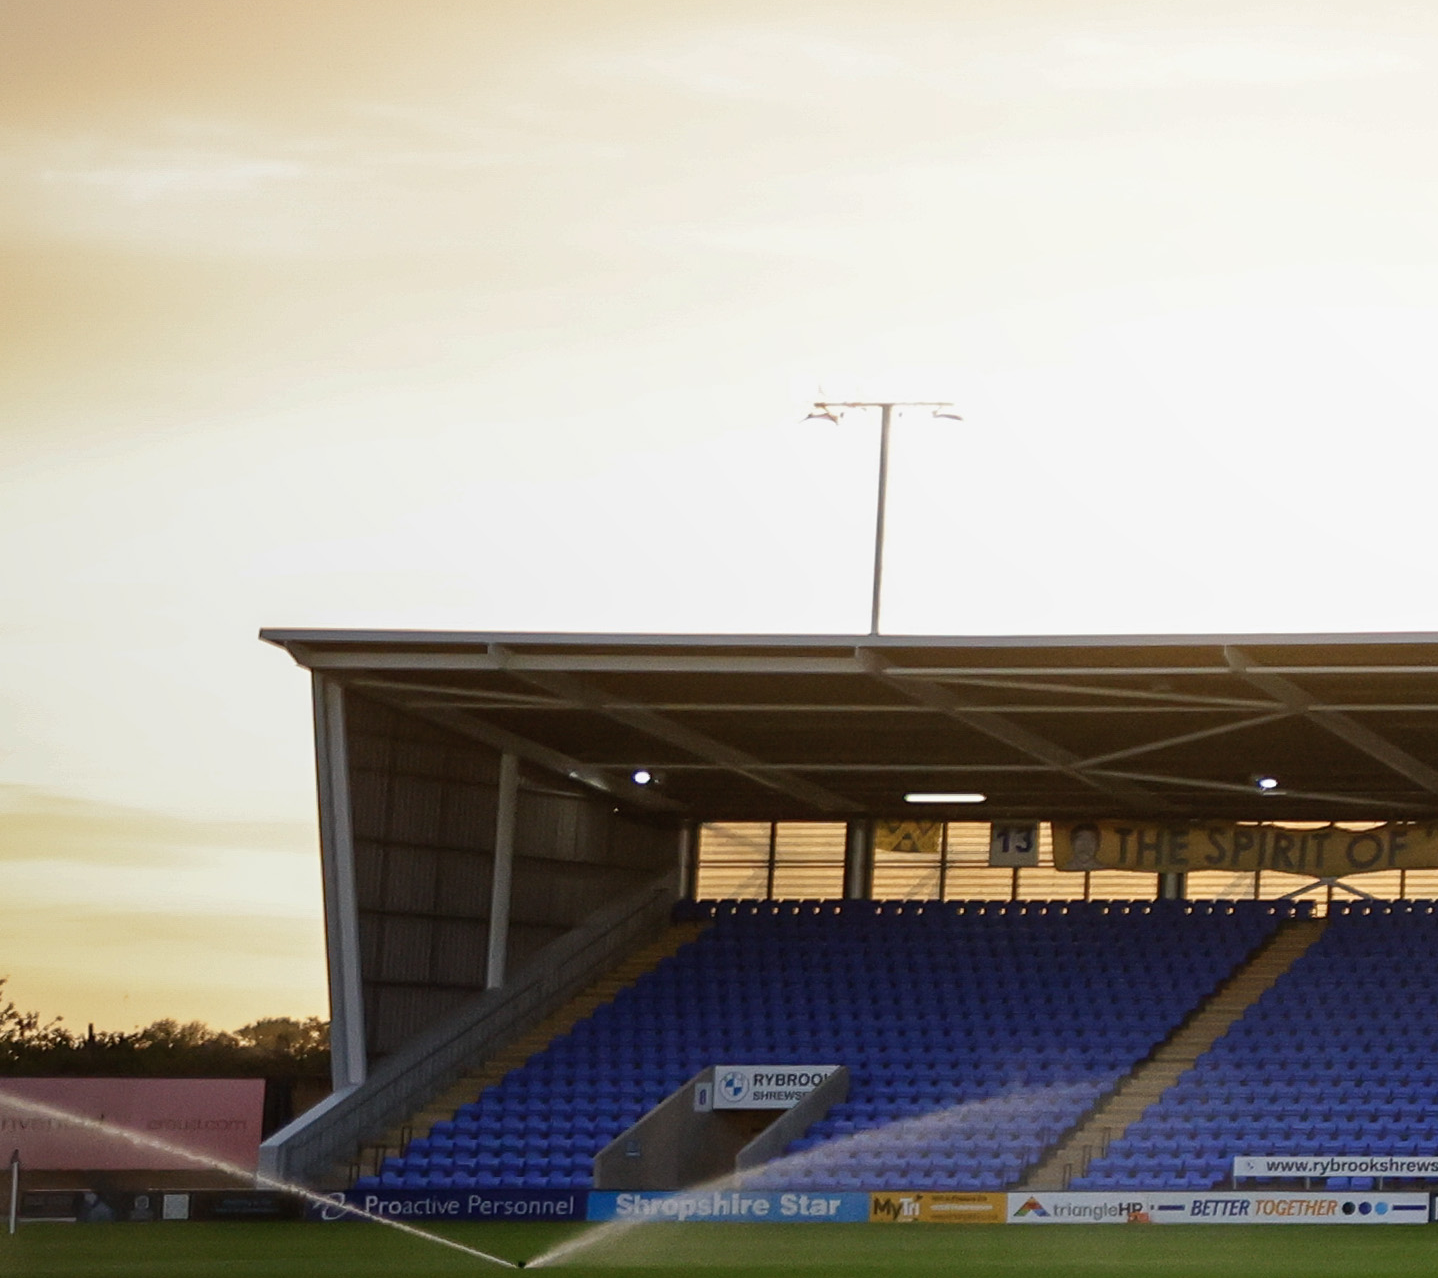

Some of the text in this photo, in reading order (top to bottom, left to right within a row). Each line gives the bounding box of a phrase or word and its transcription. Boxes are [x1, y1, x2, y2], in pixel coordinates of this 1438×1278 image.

[996, 827, 1033, 854] 13
[1113, 829, 1189, 866] THE
[1206, 828, 1333, 870] SPIRIT
[1344, 831, 1410, 870] OF
[753, 1073, 829, 1087] RYBROO
[365, 1194, 575, 1215] Proactive Personnel
[616, 1193, 842, 1221] Shropshire Star
[1190, 1199, 1339, 1217] BETTER TOGETHER
